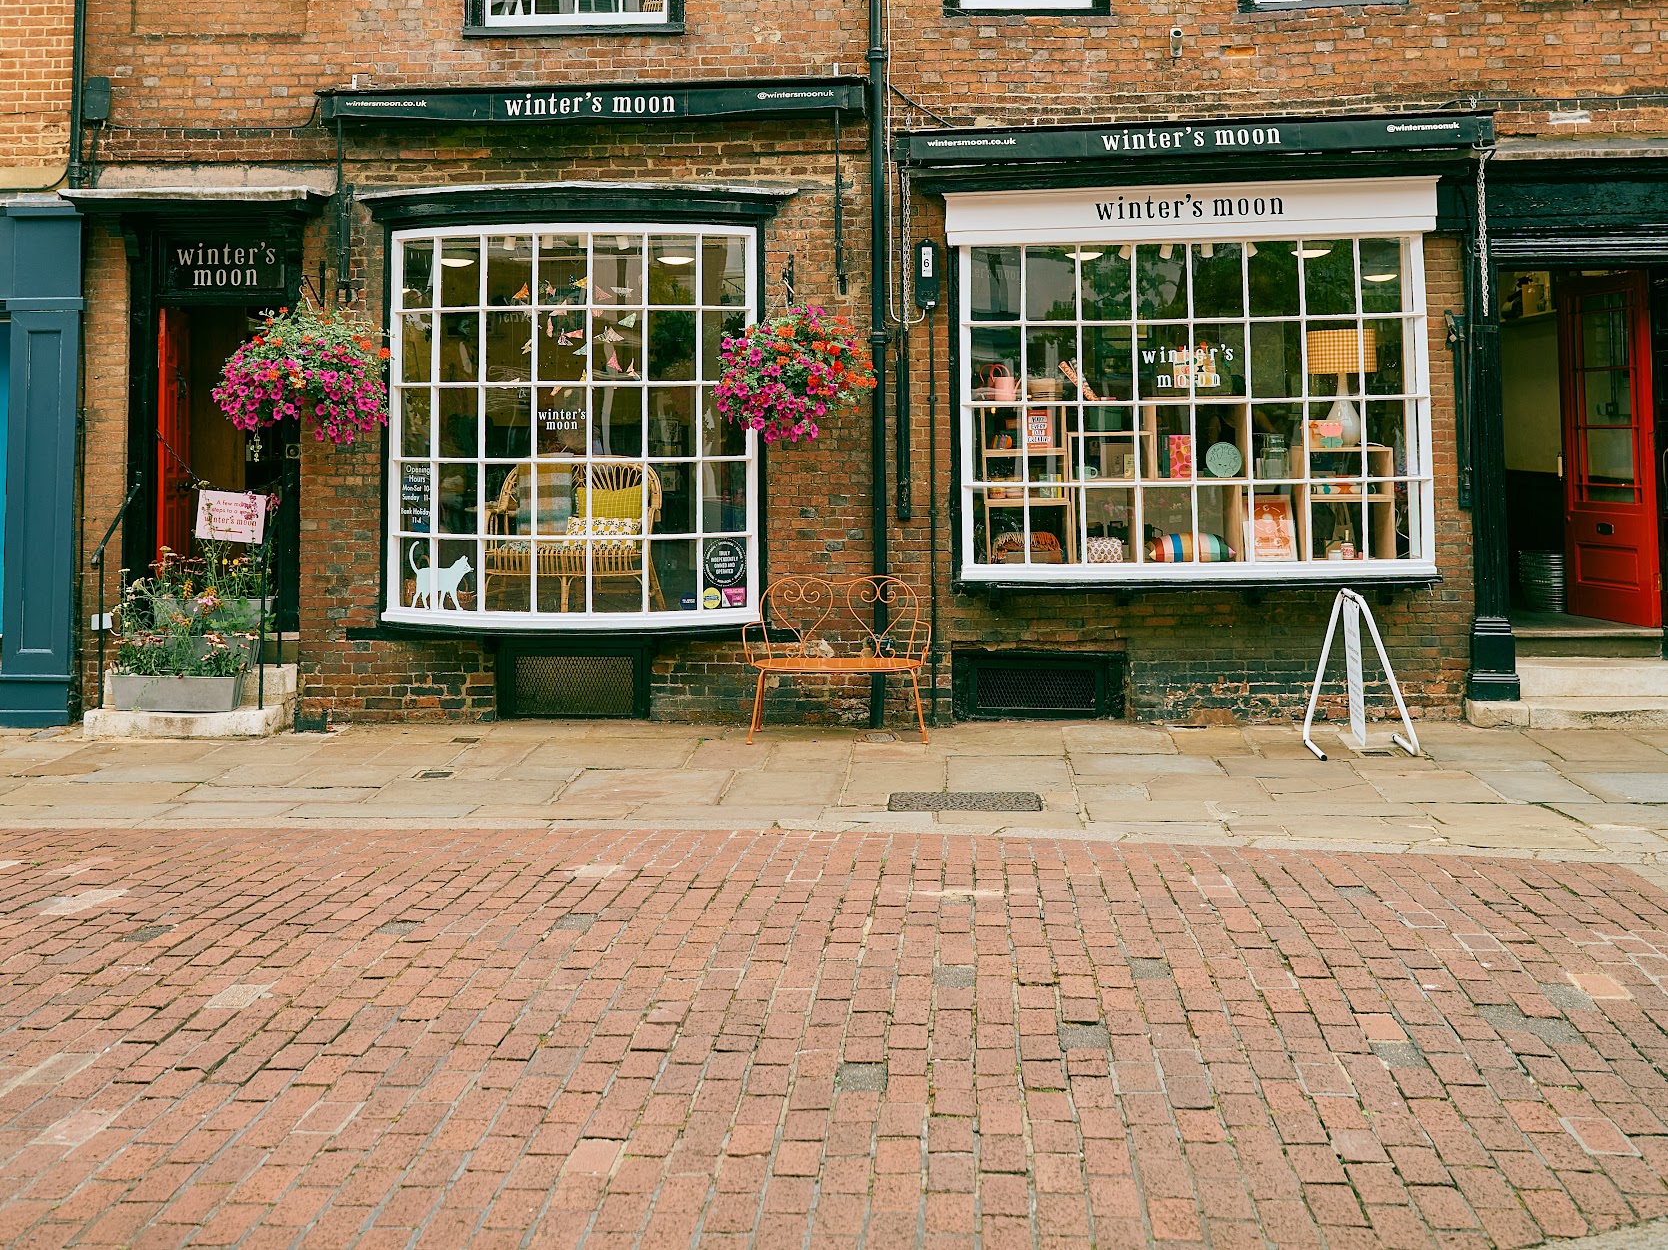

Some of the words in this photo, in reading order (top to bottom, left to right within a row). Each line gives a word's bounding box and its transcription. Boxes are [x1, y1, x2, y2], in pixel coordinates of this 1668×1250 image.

[757, 89, 835, 100] @wintersmoonuk
[345, 99, 427, 108] wintersmoon.co.uk
[504, 91, 603, 116] winter's
[611, 95, 676, 114] moon
[1386, 121, 1460, 133] @wintersmoonuk
[927, 137, 1017, 147] wintersmoon.co.uk
[1100, 126, 1205, 151] winter's
[1213, 127, 1282, 146] moon
[1095, 193, 1203, 221] winter's
[1212, 196, 1284, 217] moon
[176, 241, 276, 266] winter's
[923, 258, 930, 268] 6
[192, 268, 258, 286] moon
[1141, 343, 1234, 364] winter's
[1156, 373, 1221, 388] moon
[538, 408, 586, 420] winter's
[546, 421, 578, 430] moon
[406, 465, 430, 475] Opening
[408, 475, 426, 483] Hours
[402, 493, 420, 502] Sunday
[401, 507, 412, 515] Bank
